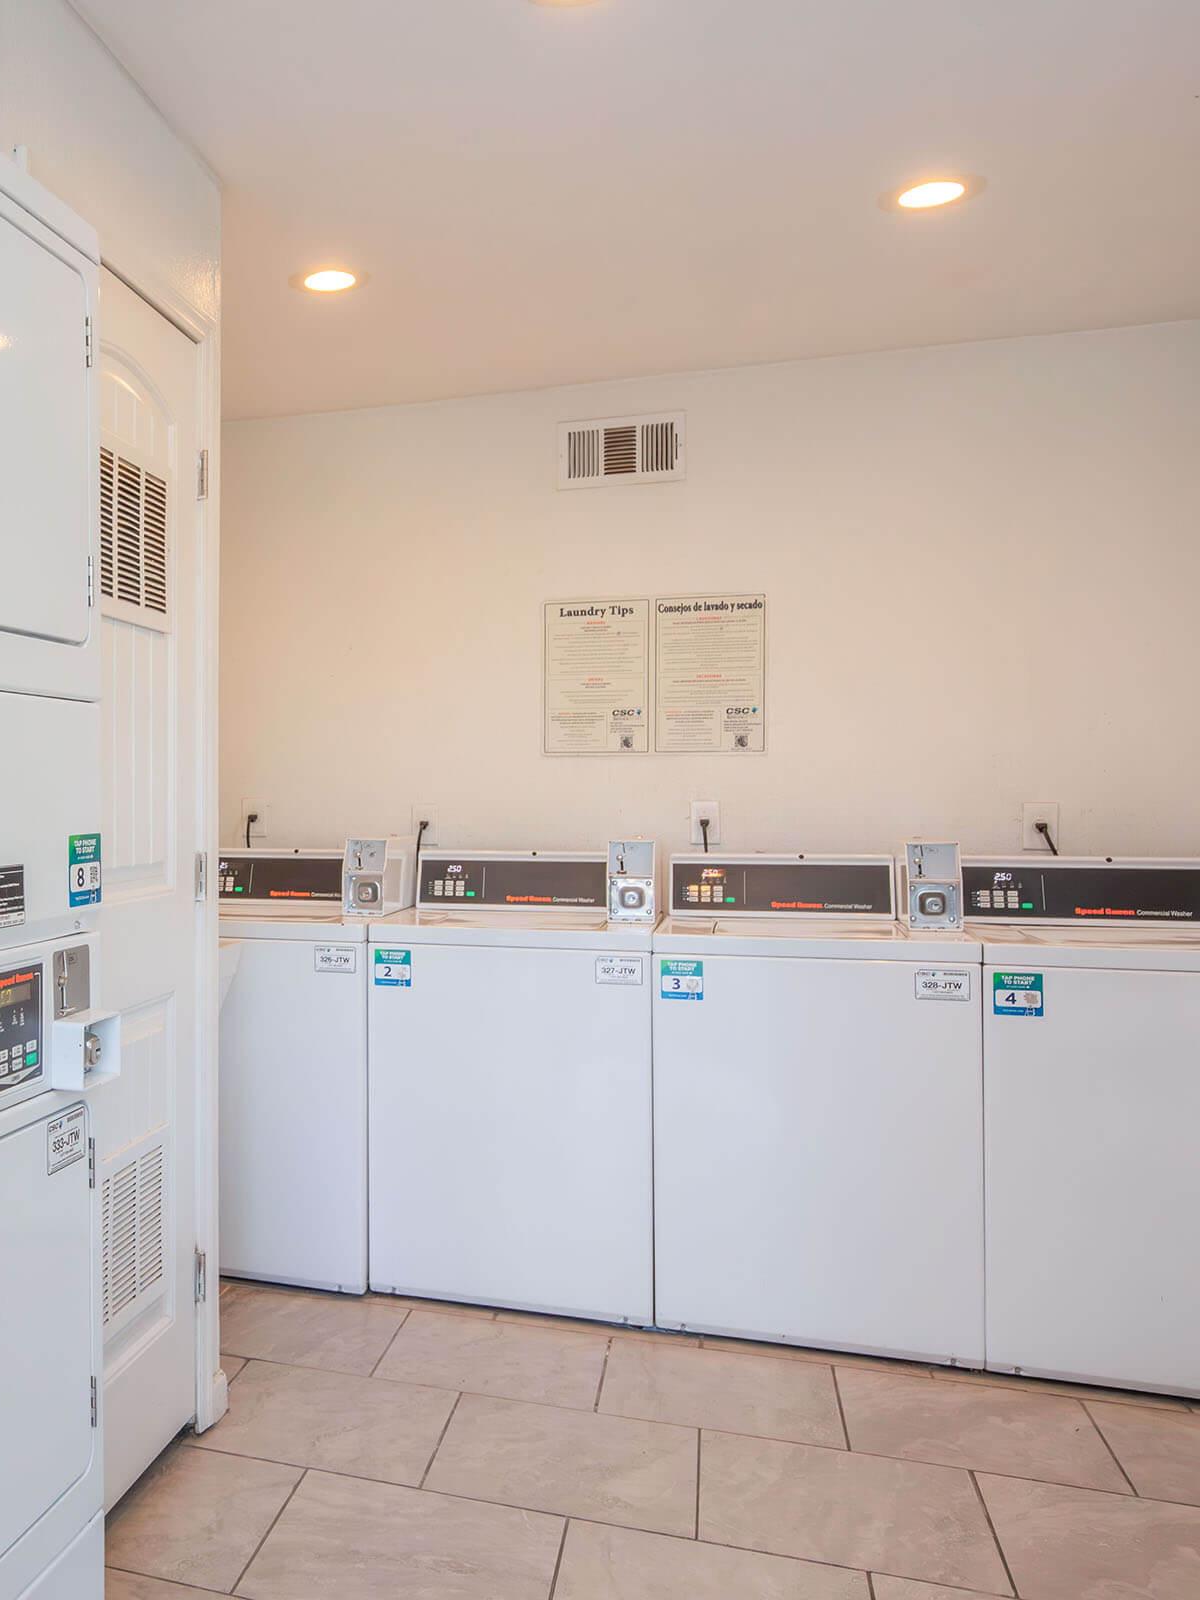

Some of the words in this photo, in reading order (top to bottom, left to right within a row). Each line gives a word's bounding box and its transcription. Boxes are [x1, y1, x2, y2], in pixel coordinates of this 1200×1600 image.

[560, 606, 606, 618] Laundry
[609, 606, 634, 617] Tips
[658, 603, 691, 615] Consejos
[693, 602, 702, 611] de
[704, 601, 728, 611] lavado
[731, 603, 735, 613] y
[737, 600, 762, 609] secado
[77, 867, 84, 887] 8
[506, 895, 528, 904] Speed
[771, 901, 796, 909] Speed
[1075, 907, 1105, 916] Speed
[384, 966, 392, 977] 2
[601, 967, 636, 975] 327-JTW
[16, 972, 33, 983] Queen
[672, 978, 680, 990] 3
[922, 981, 963, 990] 328-JTW
[1005, 992, 1016, 1005] 4
[52, 1130, 80, 1152] 333-JTW
